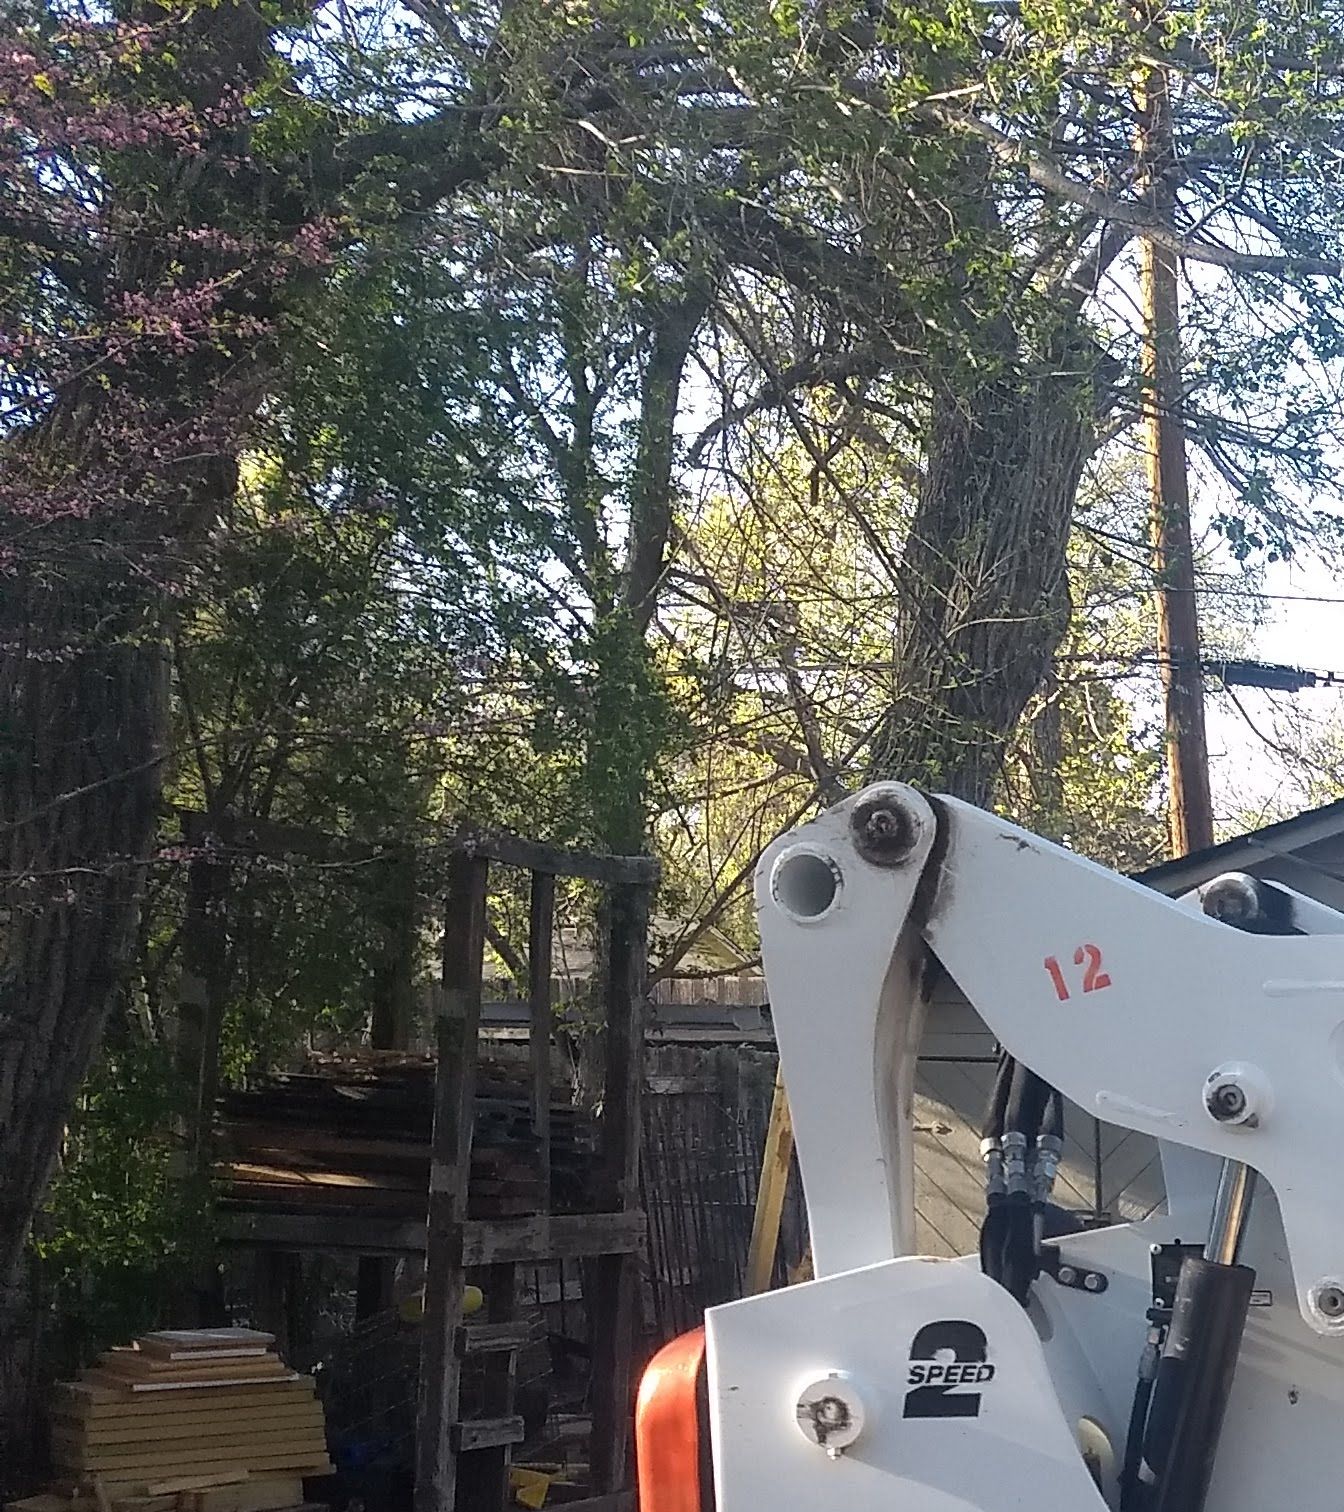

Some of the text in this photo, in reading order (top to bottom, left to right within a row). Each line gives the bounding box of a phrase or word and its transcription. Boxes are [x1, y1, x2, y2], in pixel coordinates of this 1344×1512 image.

[1044, 943, 1112, 1001] 12
[903, 1320, 987, 1418] 2
[907, 1364, 995, 1385] SPEED
